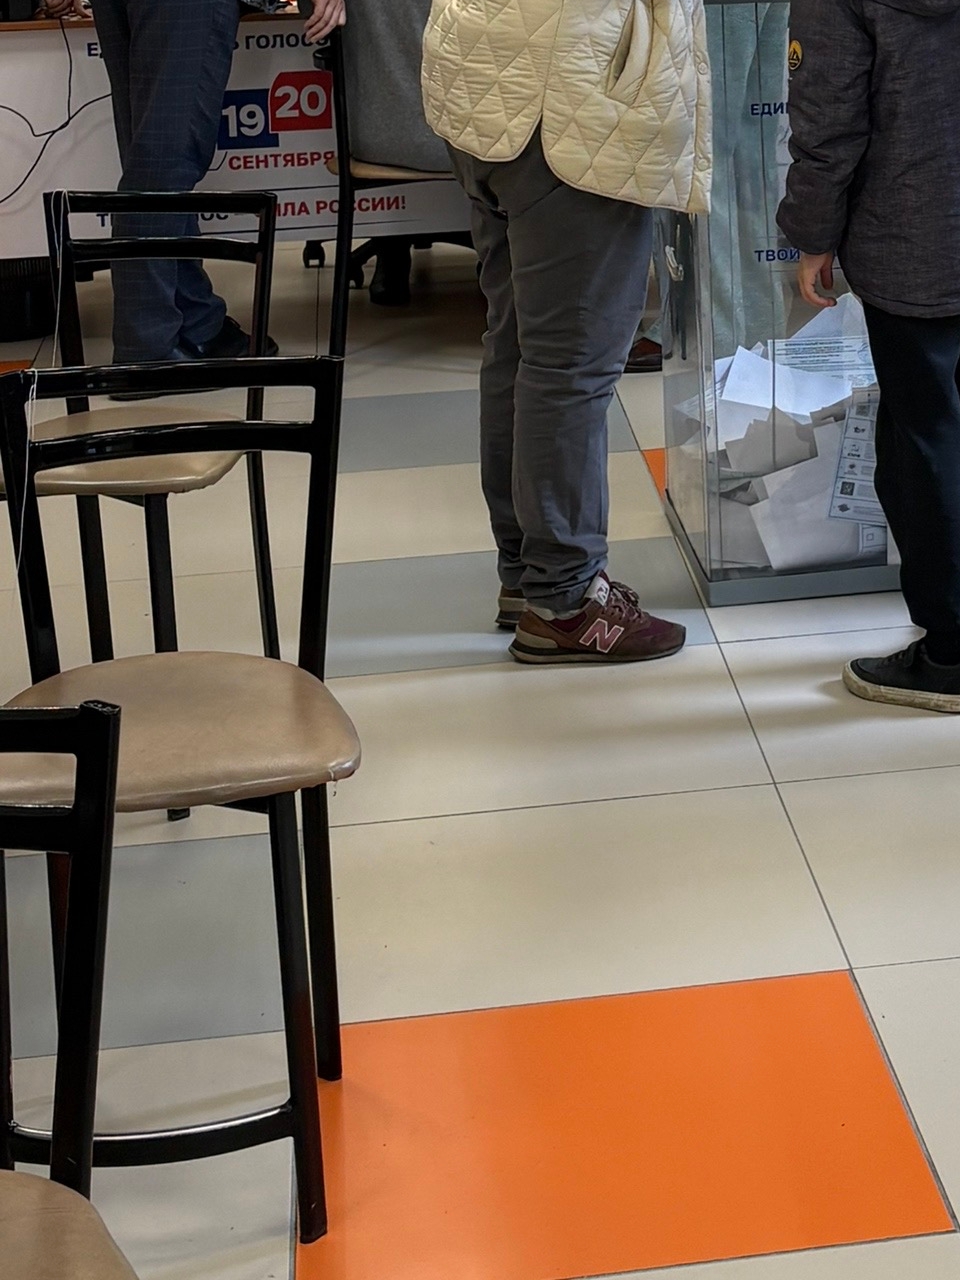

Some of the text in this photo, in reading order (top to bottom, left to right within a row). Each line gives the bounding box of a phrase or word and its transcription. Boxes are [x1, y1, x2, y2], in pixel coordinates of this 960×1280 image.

[274, 84, 327, 118] 20
[750, 102, 789, 116] ЕДИ
[222, 103, 265, 138] 19
[315, 195, 406, 215] РОСИИ!
